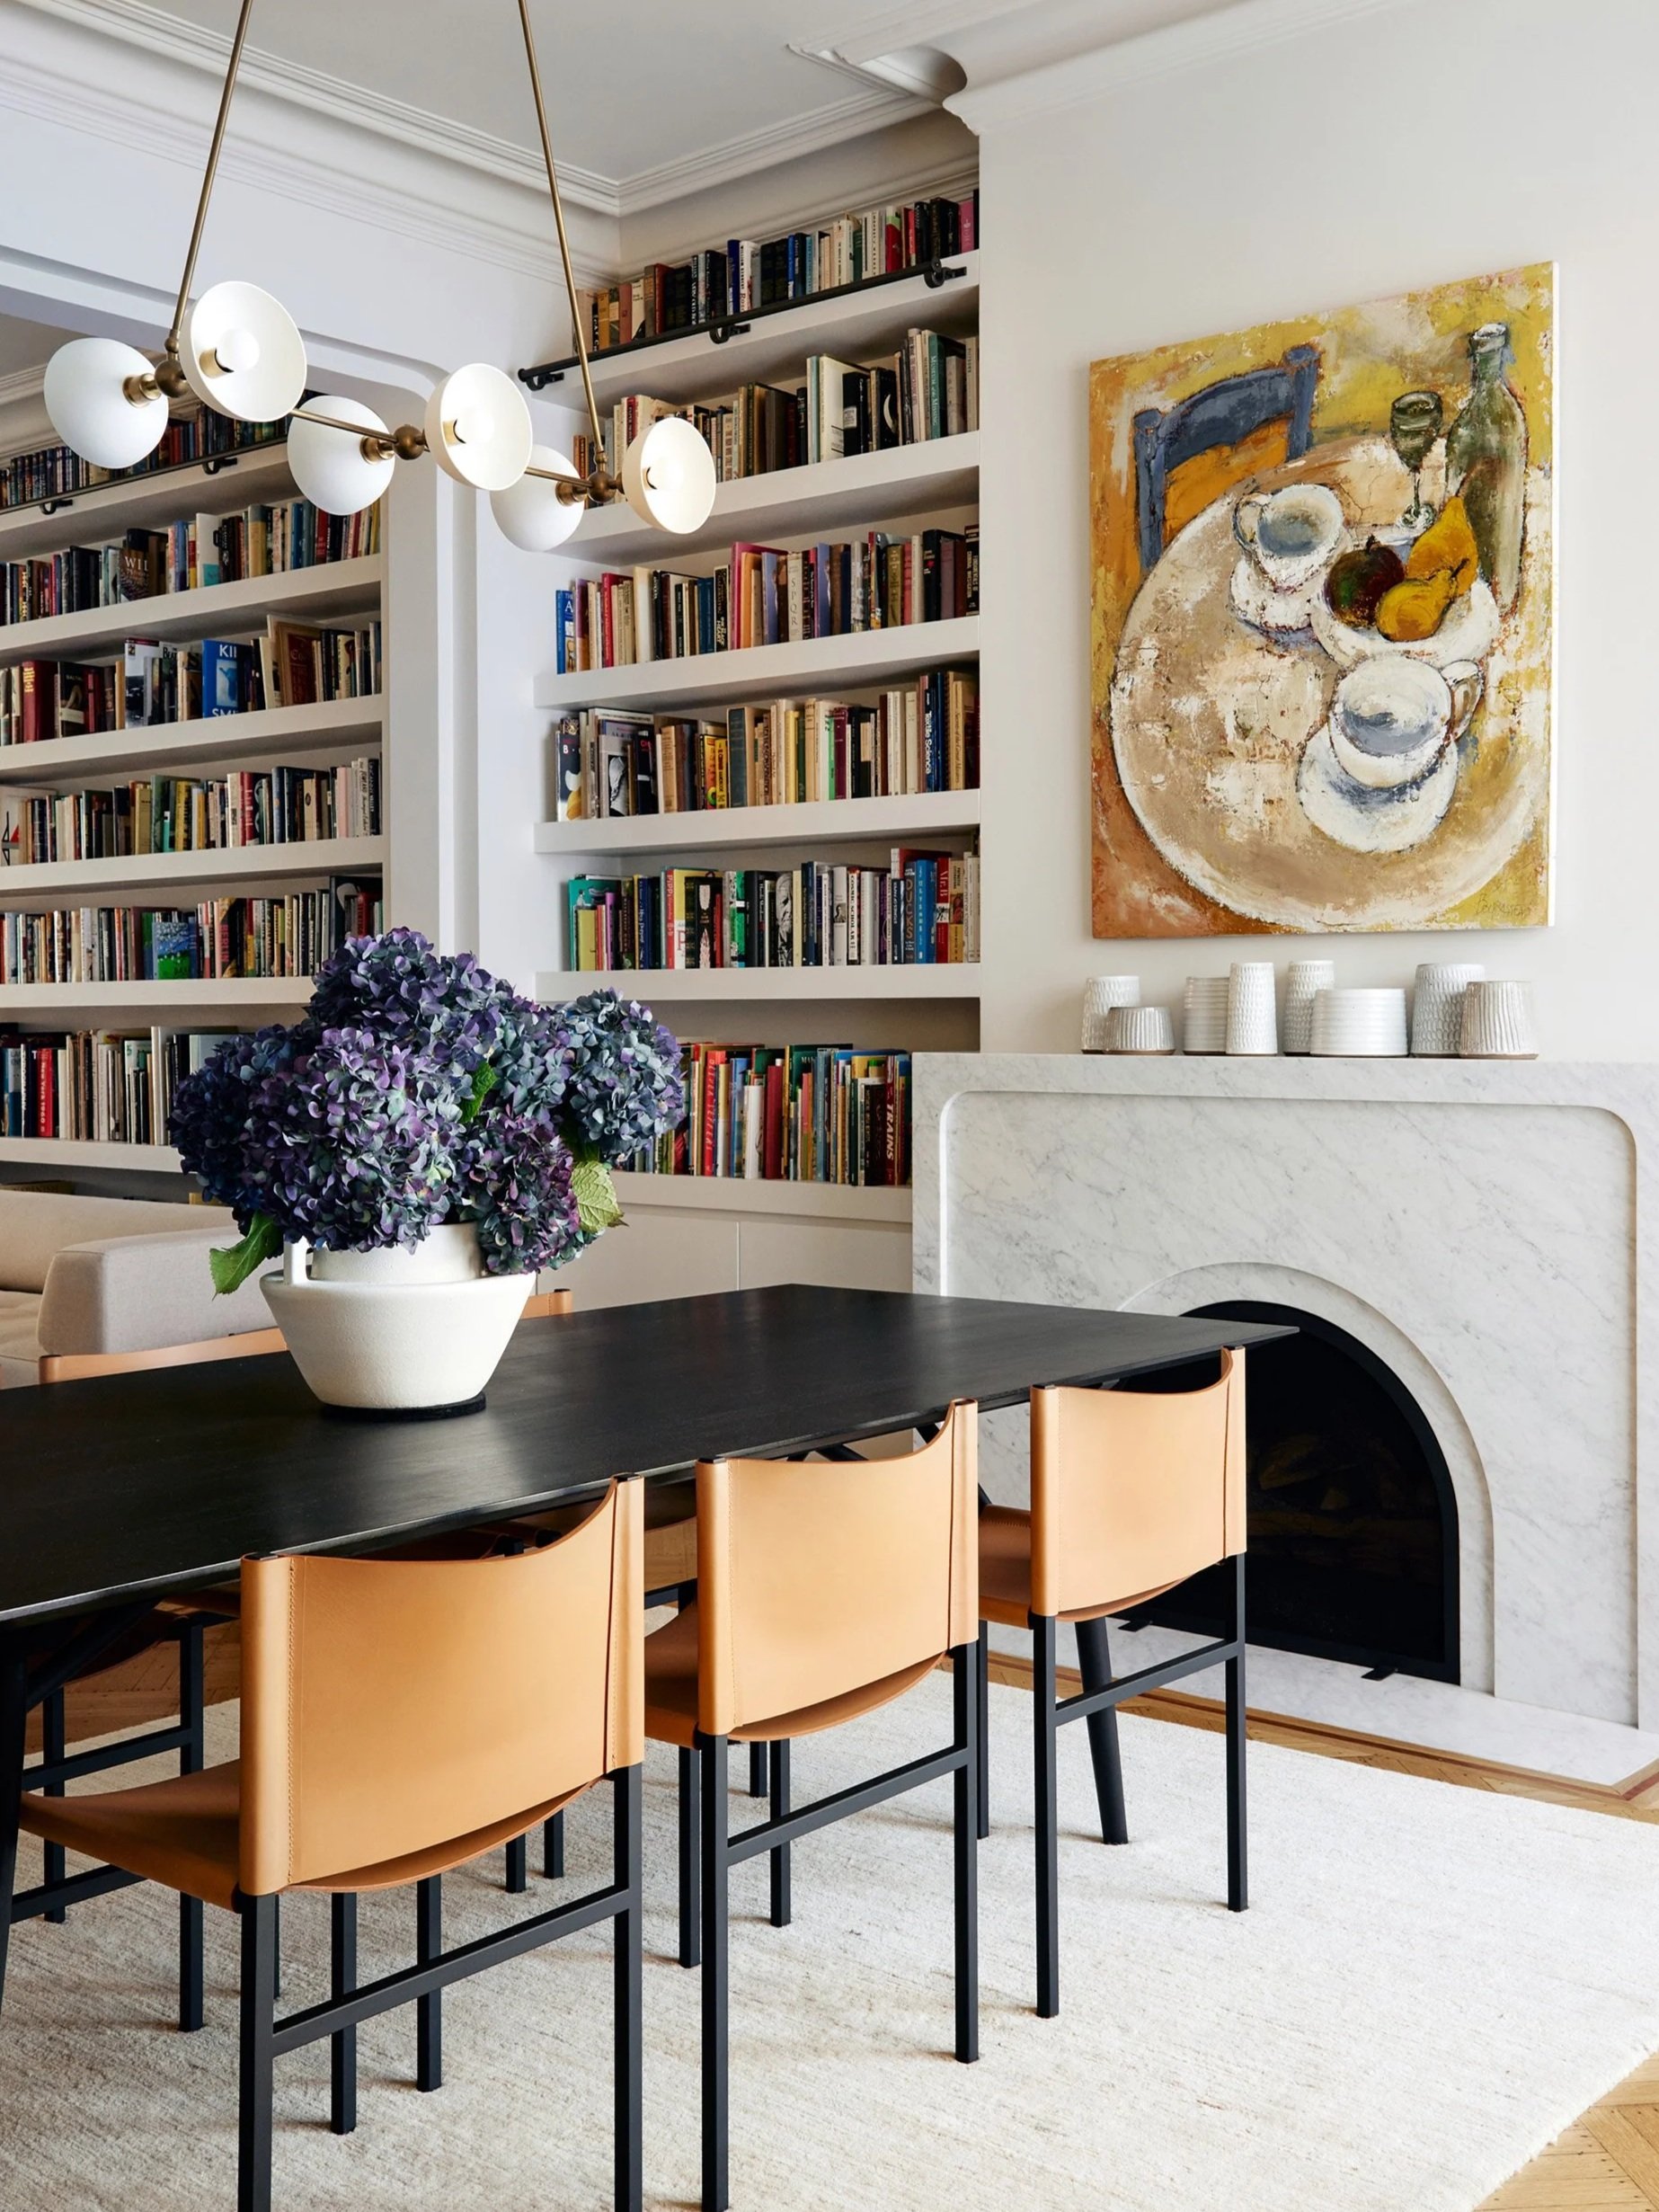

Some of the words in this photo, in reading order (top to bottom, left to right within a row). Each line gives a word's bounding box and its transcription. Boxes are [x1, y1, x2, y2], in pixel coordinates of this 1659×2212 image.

[790, 577, 798, 626] SPQR
[925, 710, 933, 738] Textile
[925, 739, 933, 775] Science
[905, 878, 915, 939] DUCKS
[220, 924, 230, 963] BERLIN
[705, 1104, 715, 1151] JEFFERS
[886, 1103, 895, 1160] TRAINS
